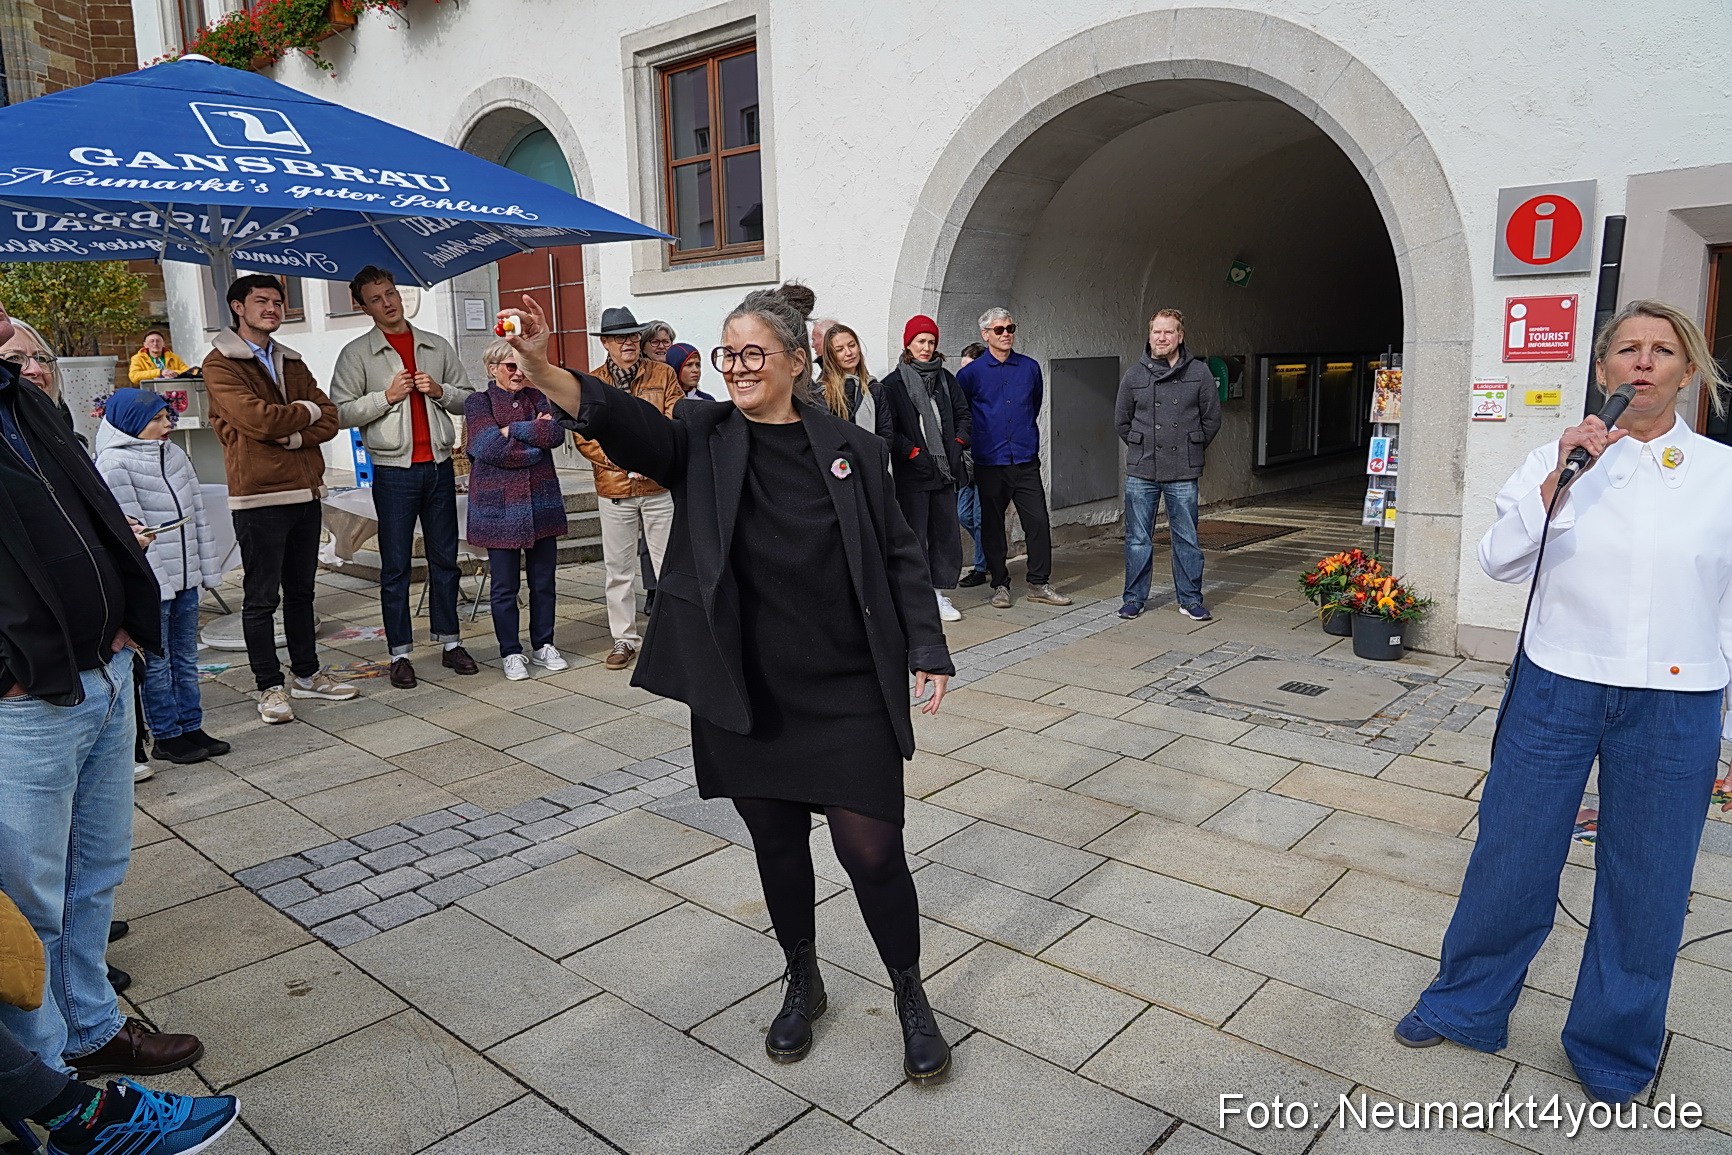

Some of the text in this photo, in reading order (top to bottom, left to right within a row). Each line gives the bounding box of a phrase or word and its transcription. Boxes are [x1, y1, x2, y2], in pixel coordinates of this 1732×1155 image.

[69, 146, 450, 192] GANSBRÄU
[0, 167, 538, 221] Neumarkt's guter Schluck
[1528, 332, 1570, 341] TOURIST
[1370, 460, 1383, 470] 14
